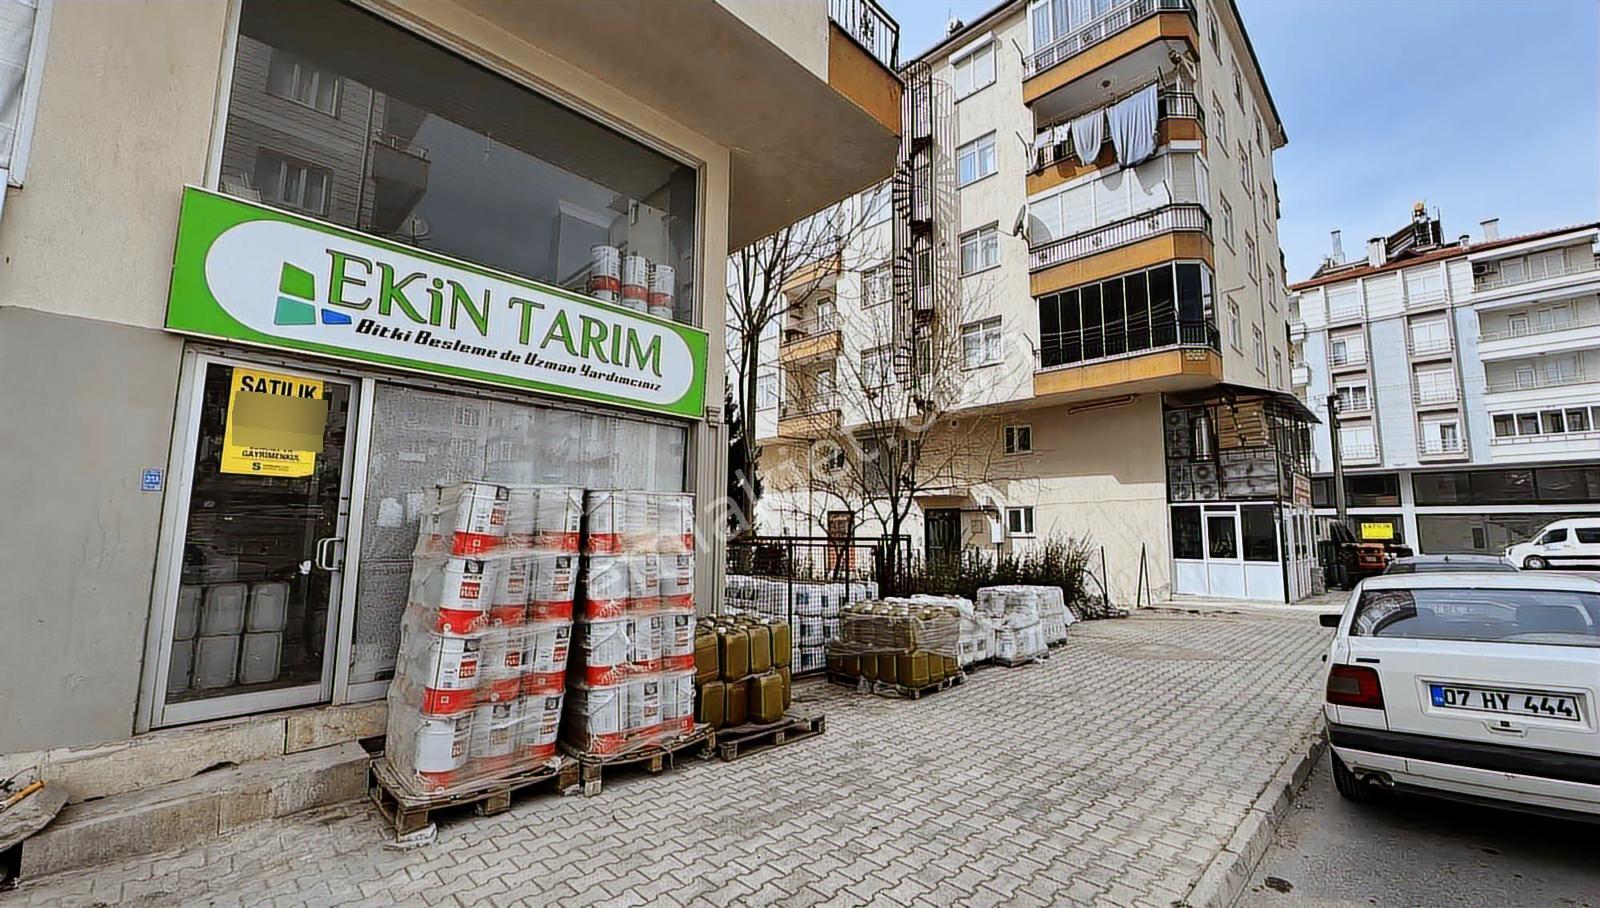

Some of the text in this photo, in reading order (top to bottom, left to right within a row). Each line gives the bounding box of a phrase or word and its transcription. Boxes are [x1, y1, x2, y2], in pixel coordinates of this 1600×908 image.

[355, 318, 413, 342] Bitki
[414, 330, 498, 359] Besleme
[500, 349, 522, 363] de
[524, 352, 577, 375] Uzman
[508, 297, 663, 378] TARIM
[1443, 687, 1573, 717] 07 HY 444
